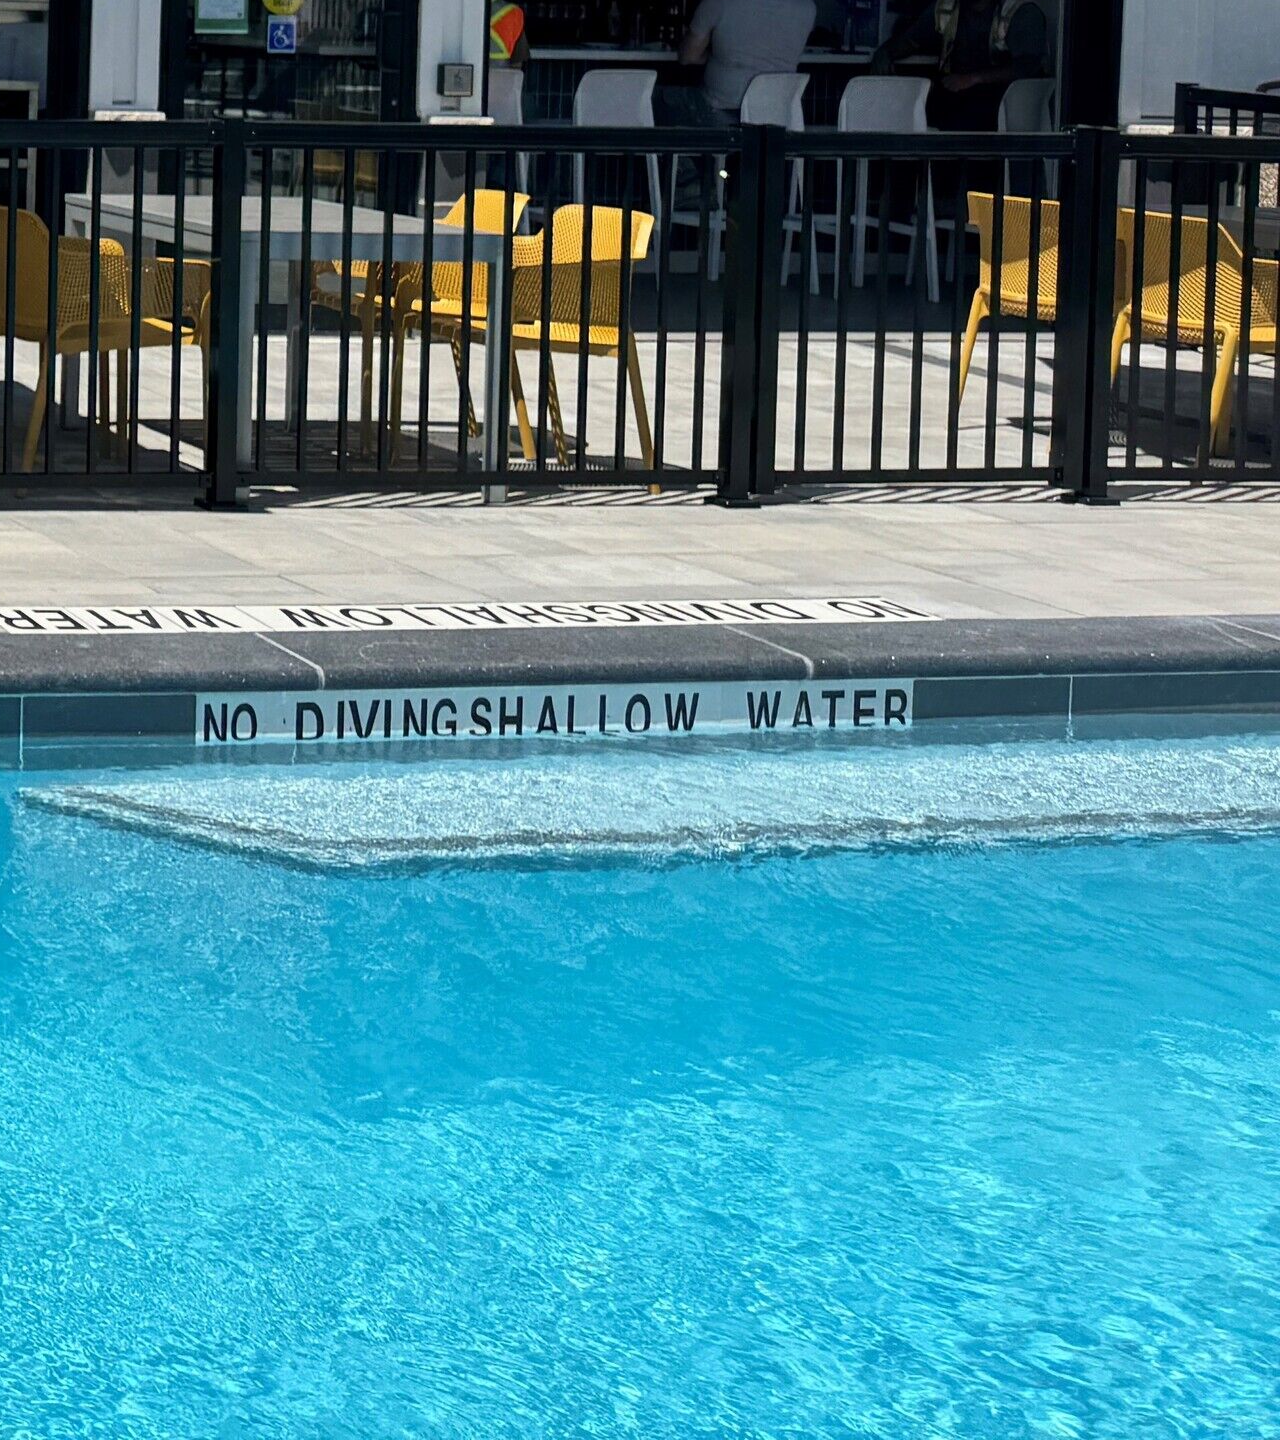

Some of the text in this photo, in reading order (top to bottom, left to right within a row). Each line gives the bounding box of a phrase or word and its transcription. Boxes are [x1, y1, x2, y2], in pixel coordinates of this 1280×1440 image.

[828, 601, 929, 618] NO
[203, 703, 258, 742] NO
[746, 688, 908, 729] WATER
